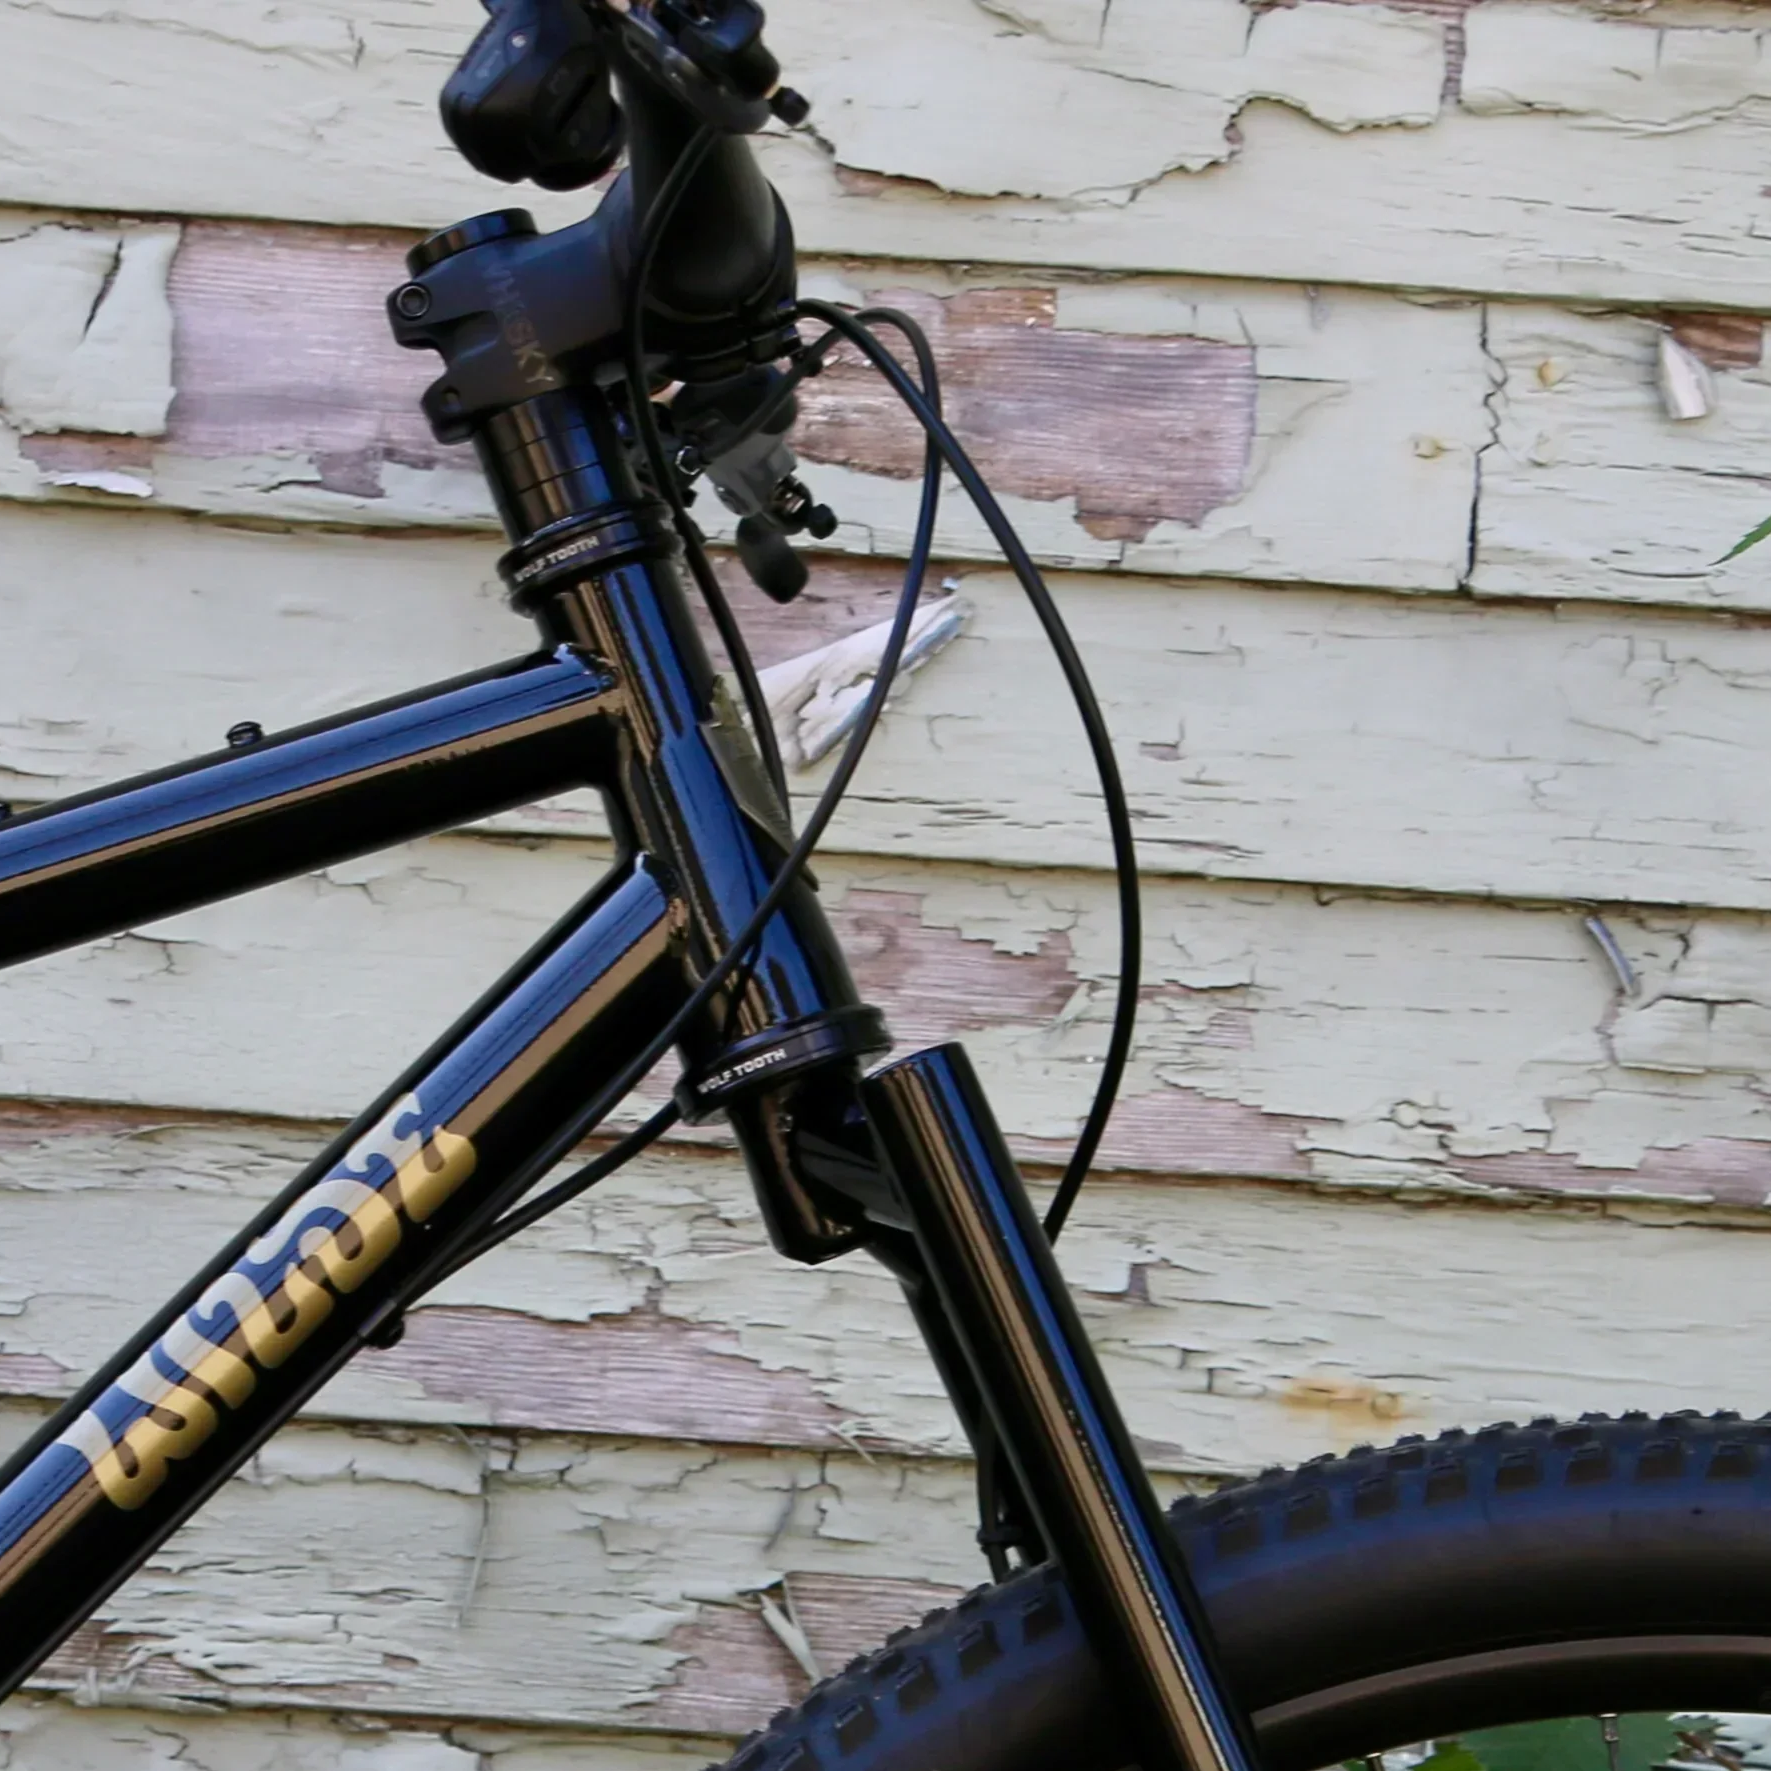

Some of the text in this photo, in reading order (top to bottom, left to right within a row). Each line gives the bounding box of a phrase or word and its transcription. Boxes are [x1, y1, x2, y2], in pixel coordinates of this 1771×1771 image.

[546, 536, 600, 564] TOOTH
[697, 1048, 787, 1094] WOLF TOOTH
[56, 1091, 477, 1511] WILDE
